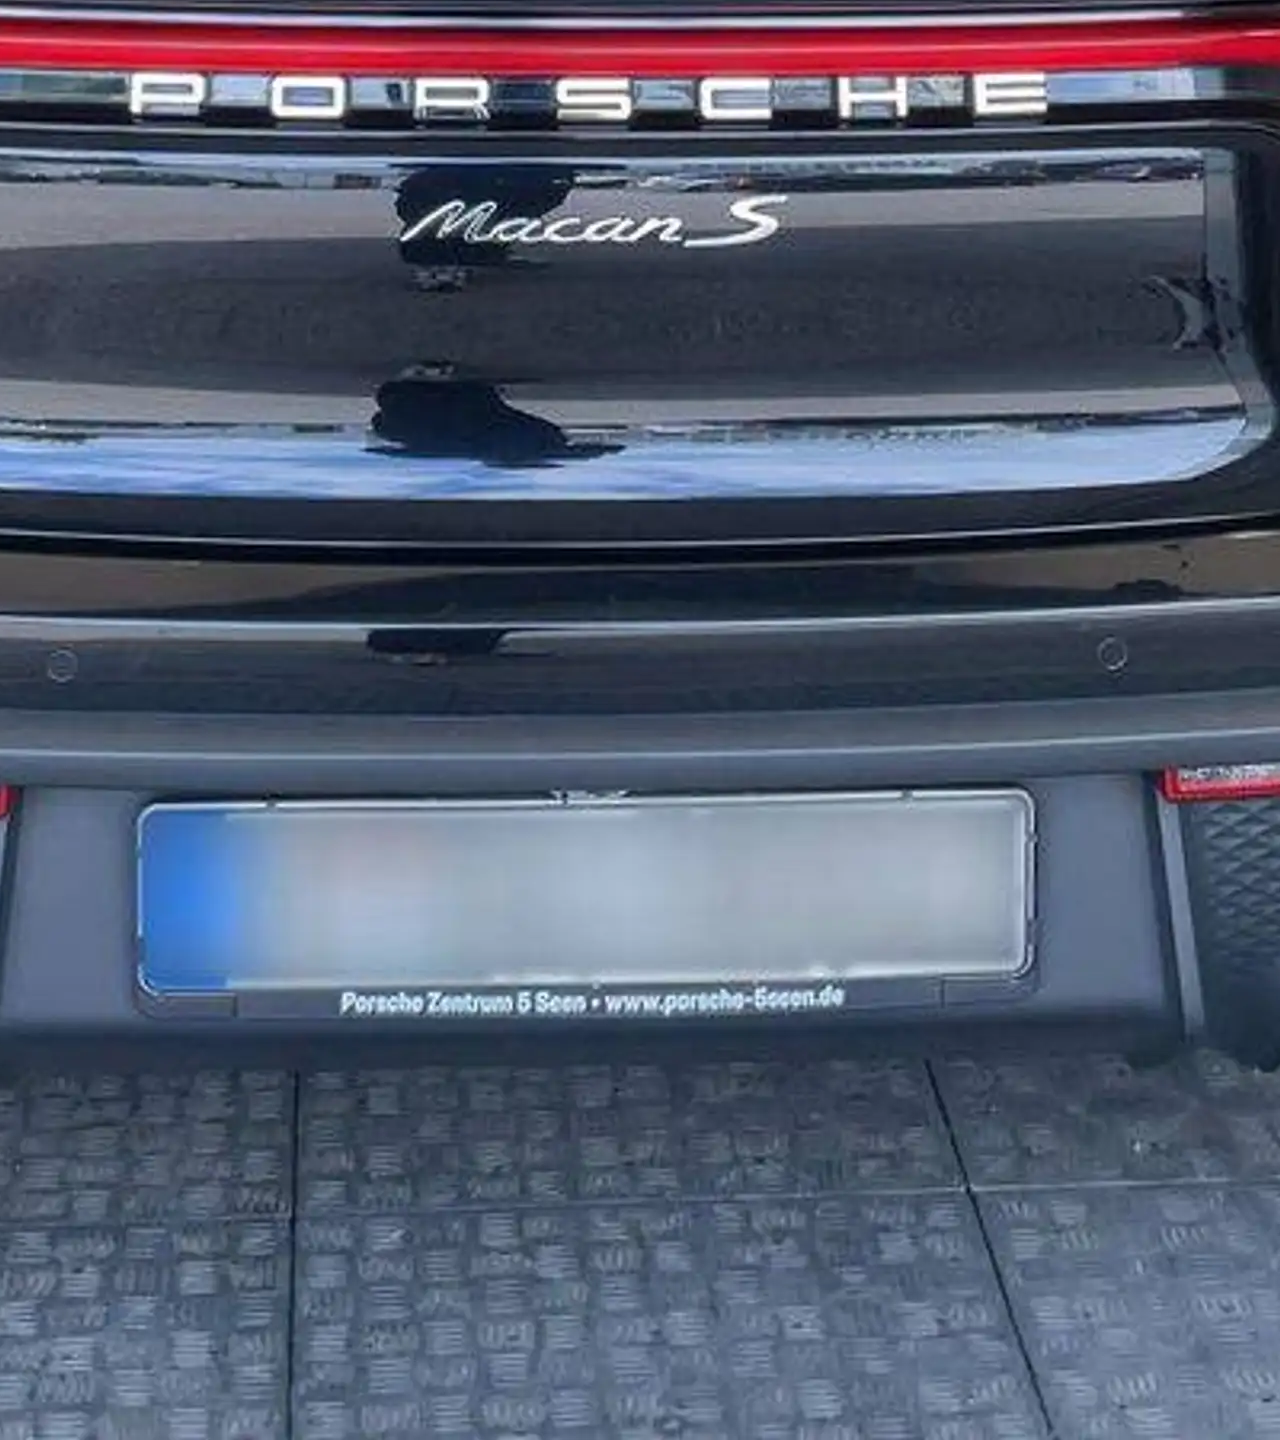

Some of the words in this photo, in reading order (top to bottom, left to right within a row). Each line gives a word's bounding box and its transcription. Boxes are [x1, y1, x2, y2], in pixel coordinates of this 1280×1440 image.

[127, 71, 1048, 121] PORSCHE
[400, 199, 683, 244] Macan
[682, 194, 788, 248] S
[340, 991, 421, 1014] Porsche
[426, 991, 513, 1013] Zentrum
